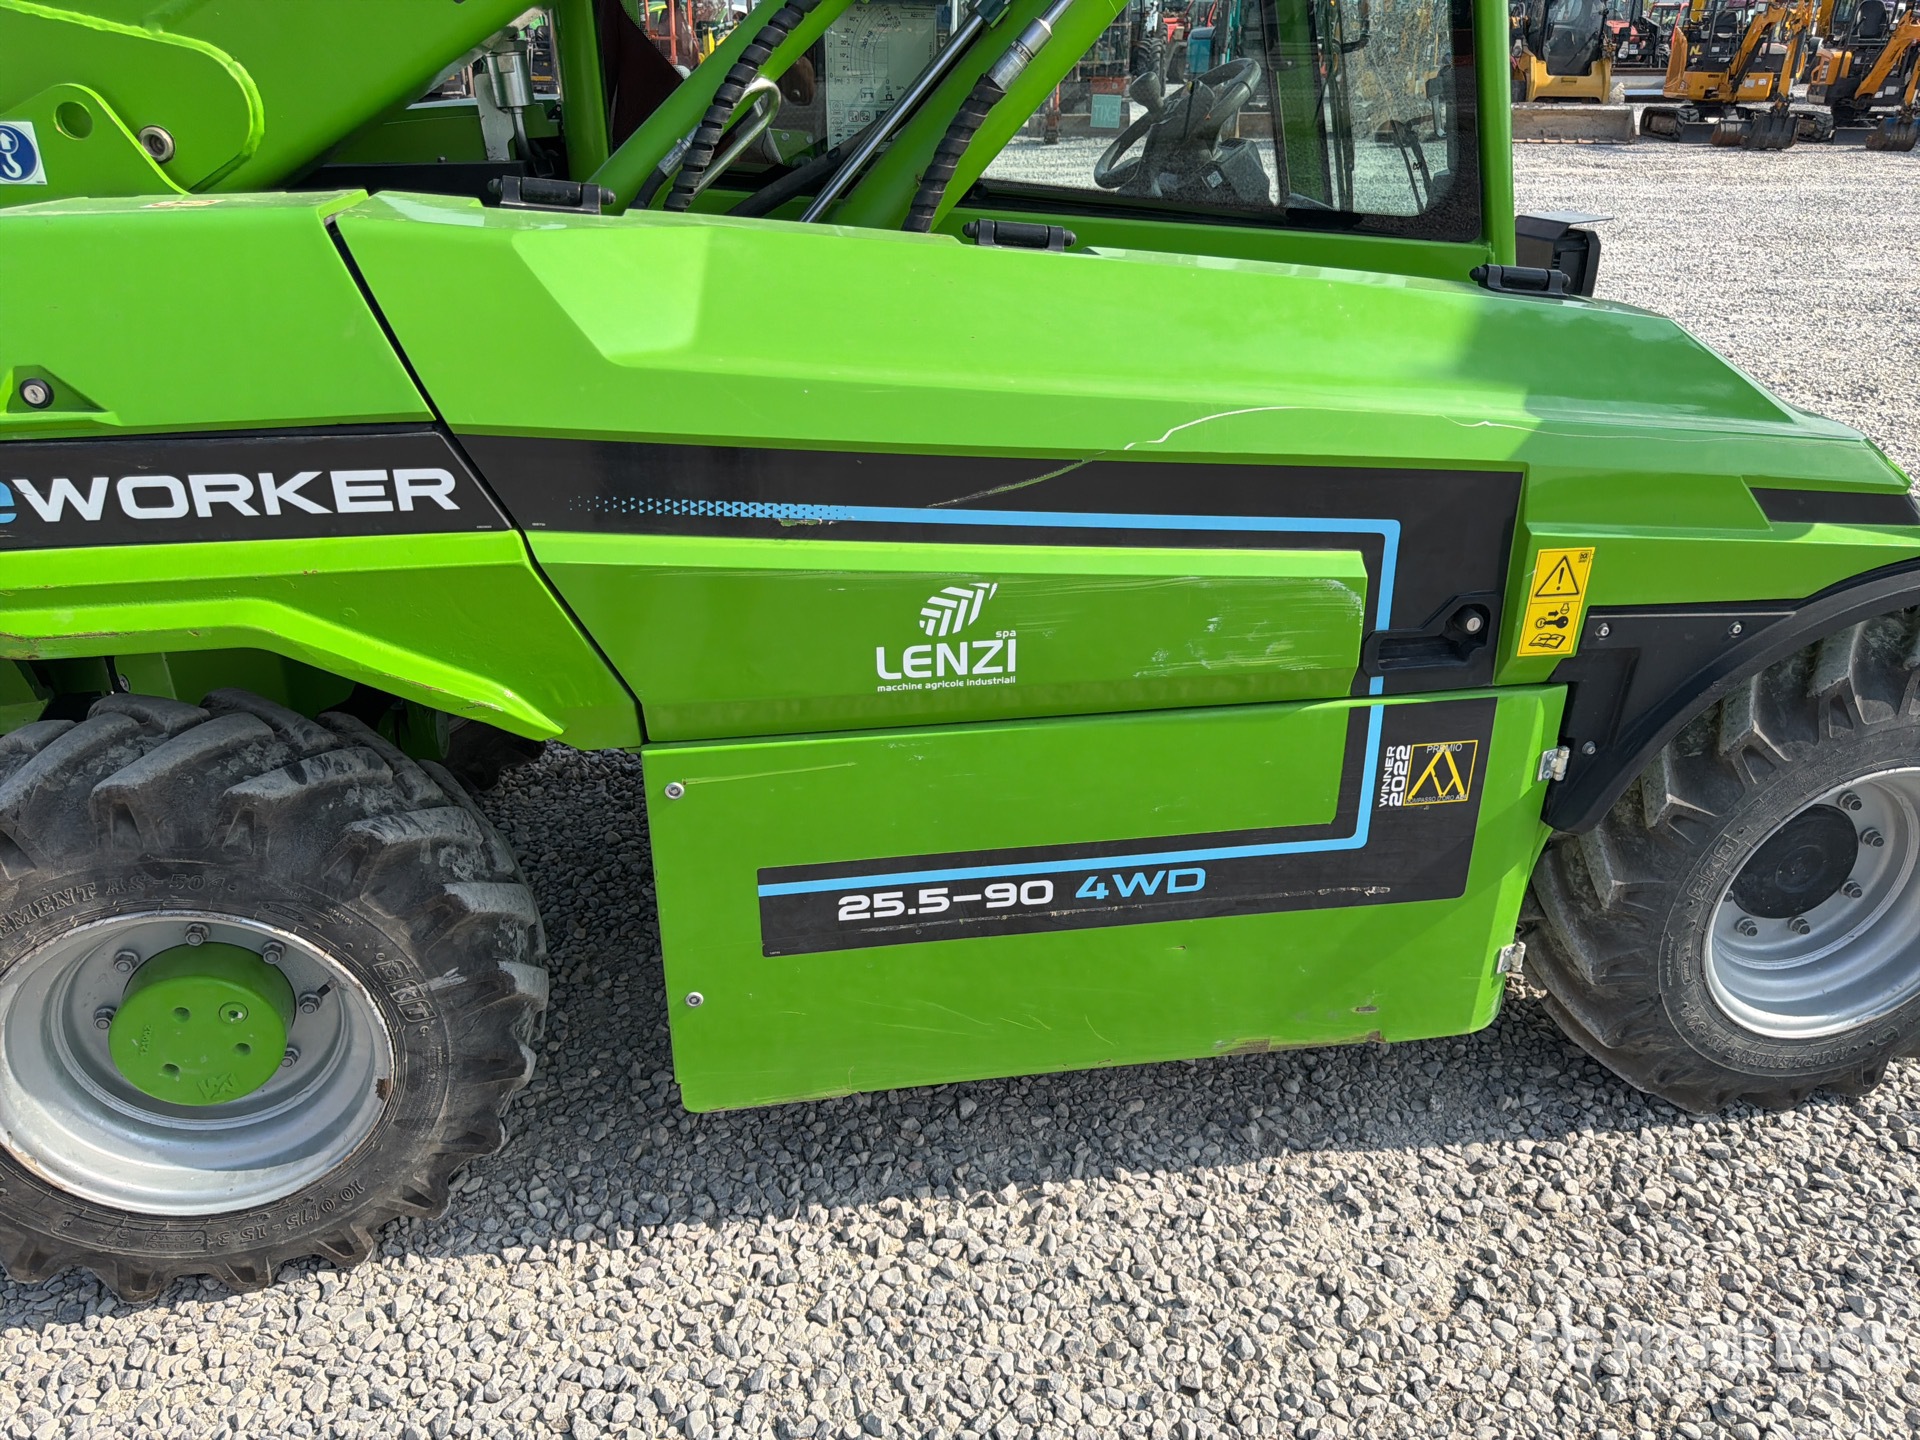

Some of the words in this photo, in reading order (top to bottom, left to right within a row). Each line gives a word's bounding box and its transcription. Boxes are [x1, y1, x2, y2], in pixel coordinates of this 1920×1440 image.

[995, 630, 1017, 639] spa
[876, 638, 1017, 680] LENZI
[877, 682, 922, 692] macchine
[925, 680, 964, 690] agricole
[967, 676, 1016, 686] industriali
[1379, 746, 1396, 807] WINNER
[1388, 745, 1411, 807] 2022
[838, 880, 1054, 921] 25.5-90
[1075, 867, 1206, 900] 4WD
